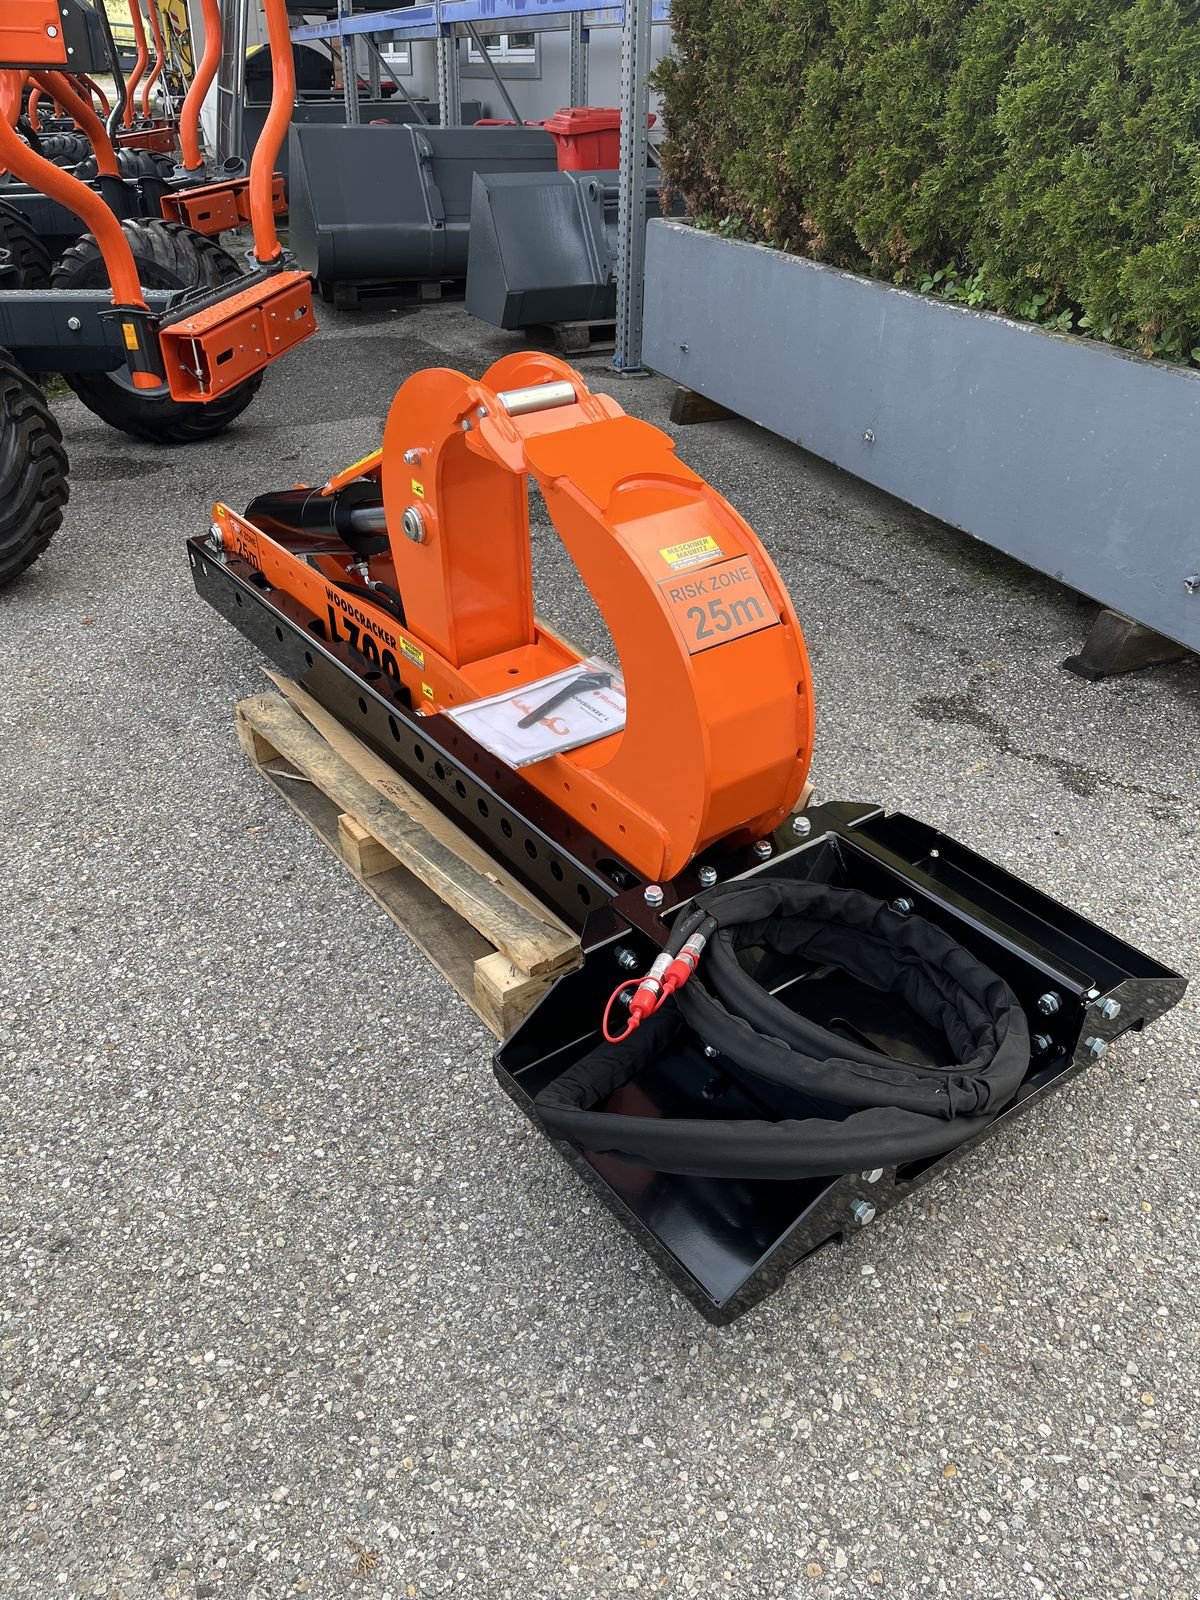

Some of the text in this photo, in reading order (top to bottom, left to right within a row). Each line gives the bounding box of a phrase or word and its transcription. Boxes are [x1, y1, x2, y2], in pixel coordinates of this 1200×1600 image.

[236, 537, 259, 570] 25m
[666, 537, 710, 556] MASCHINEN
[676, 545, 708, 560] MAURITZ
[669, 566, 752, 604] RISK ZONE
[324, 585, 398, 652] WOODCRACKER
[687, 595, 765, 641] 25m
